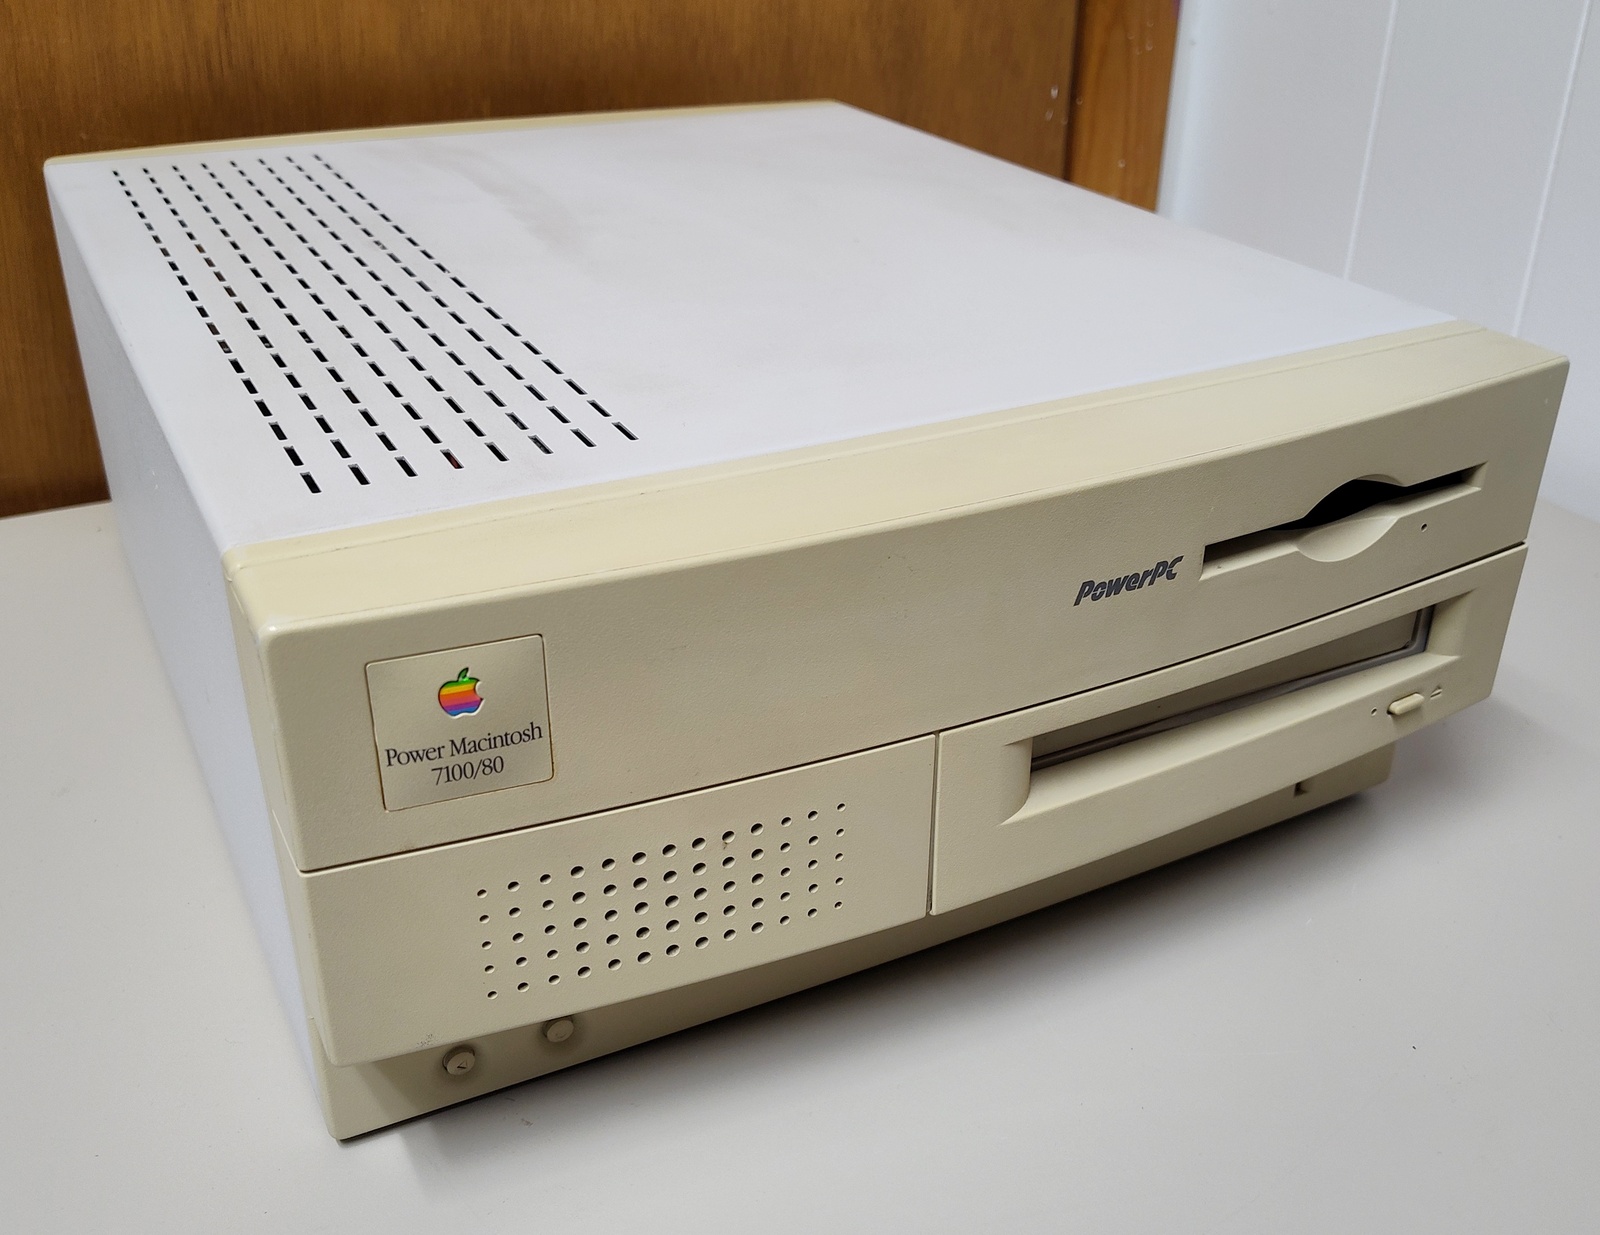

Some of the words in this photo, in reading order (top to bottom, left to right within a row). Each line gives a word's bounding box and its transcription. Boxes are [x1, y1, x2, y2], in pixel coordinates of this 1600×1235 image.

[1073, 555, 1184, 606] PowerPC
[385, 745, 445, 767] Power
[449, 722, 543, 757] Macintosh
[431, 756, 504, 786] 7100/80
